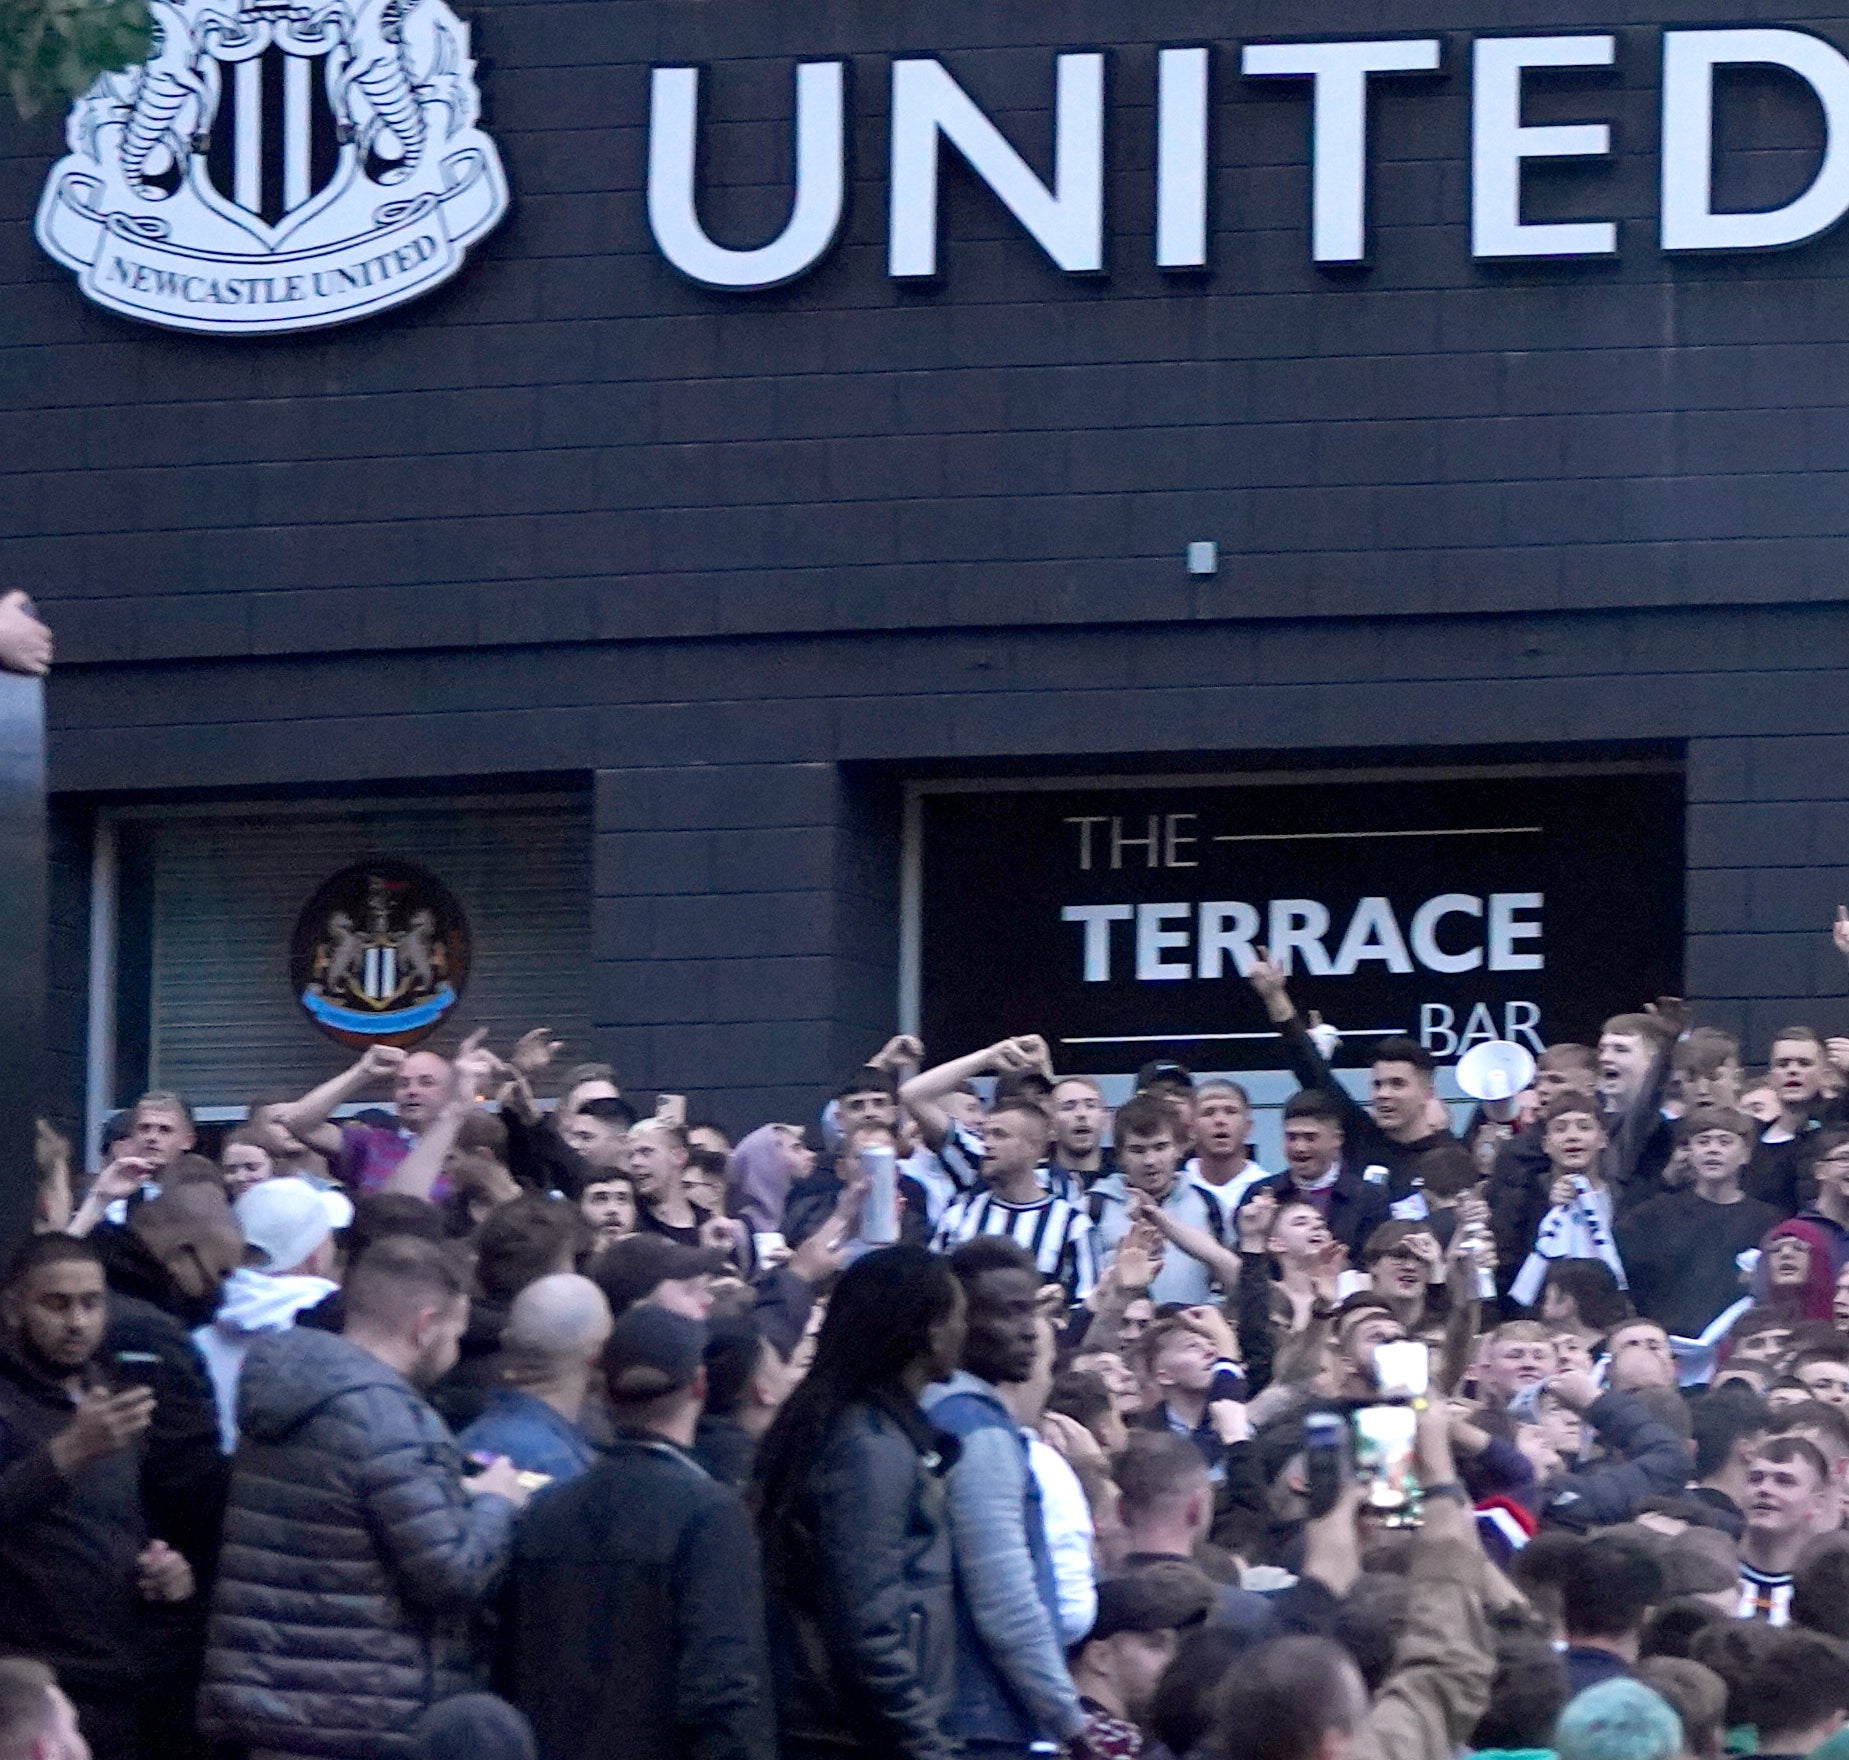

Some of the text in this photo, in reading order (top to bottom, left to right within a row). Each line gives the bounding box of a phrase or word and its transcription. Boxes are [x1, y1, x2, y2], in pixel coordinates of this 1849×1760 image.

[105, 234, 438, 304] NEWCASTLE UNITED
[1063, 813, 1199, 870] THE
[1060, 892, 1545, 983] TERRACE
[1420, 1000, 1546, 1058] BAR
